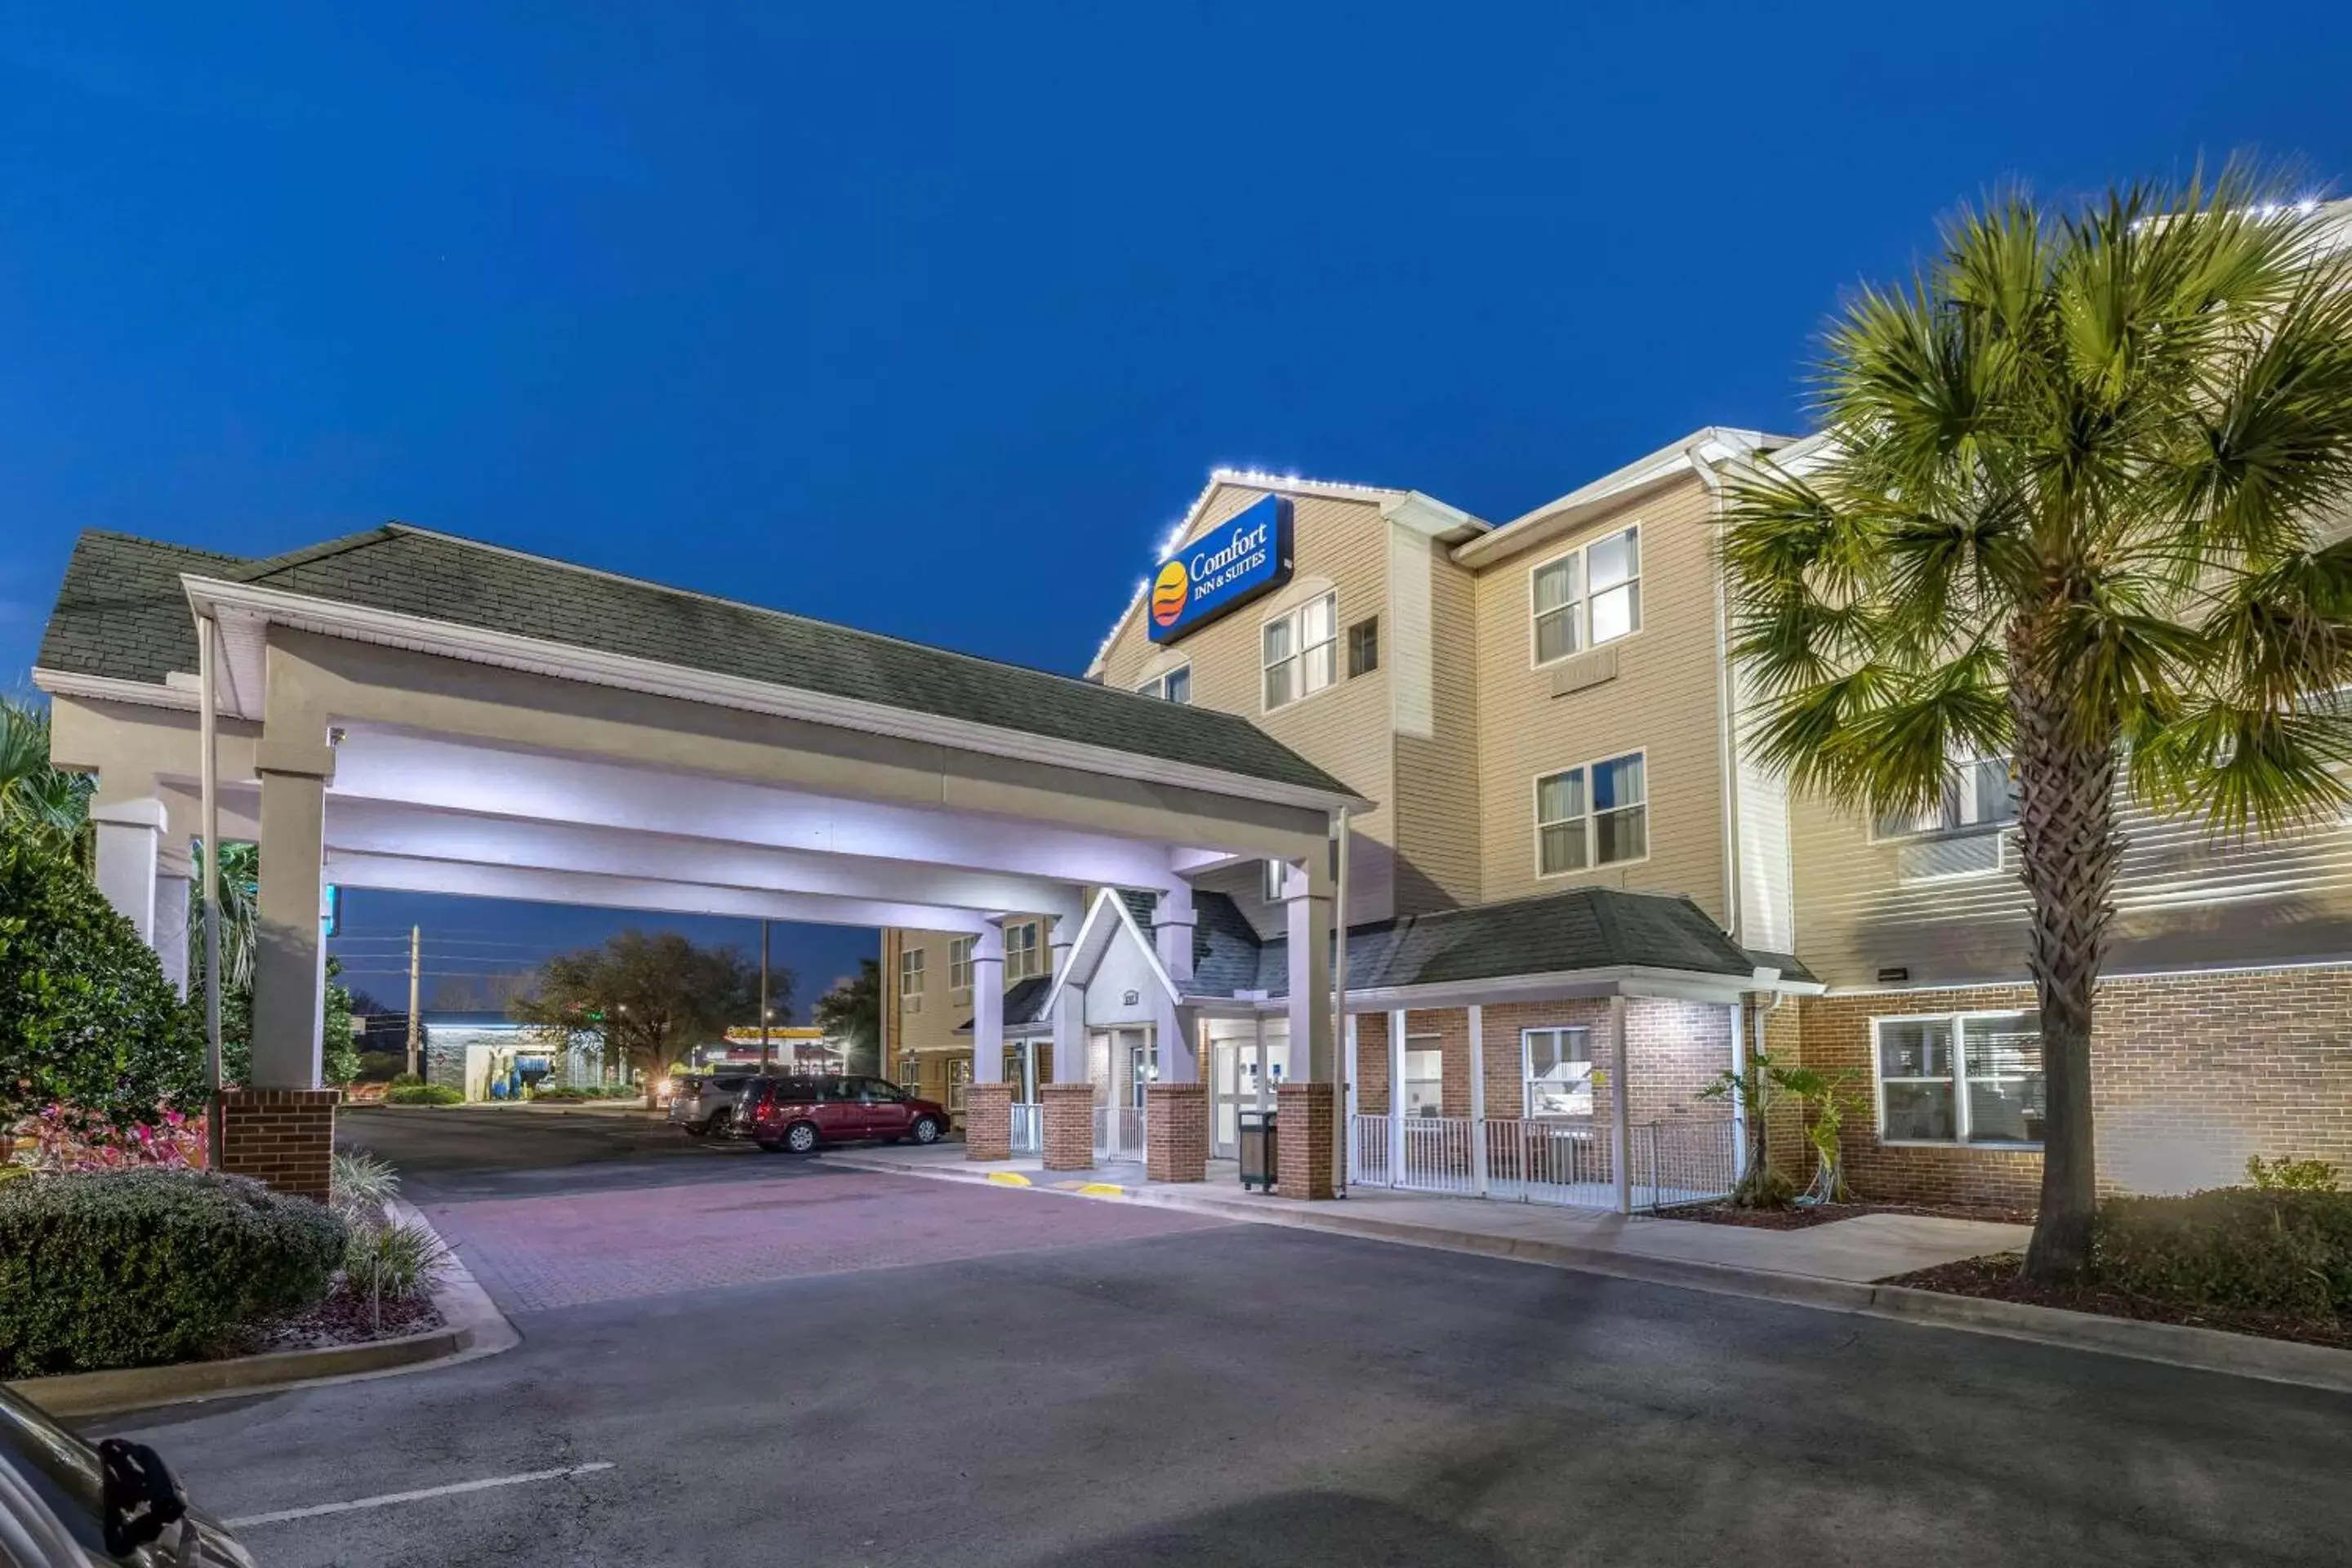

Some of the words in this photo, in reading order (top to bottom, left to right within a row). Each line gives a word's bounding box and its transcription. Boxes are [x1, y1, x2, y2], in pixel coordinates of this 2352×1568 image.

[1190, 523, 1267, 582] Comfort
[1194, 577, 1215, 601] INN
[1215, 575, 1225, 587] &
[1225, 549, 1266, 582] SUITES
